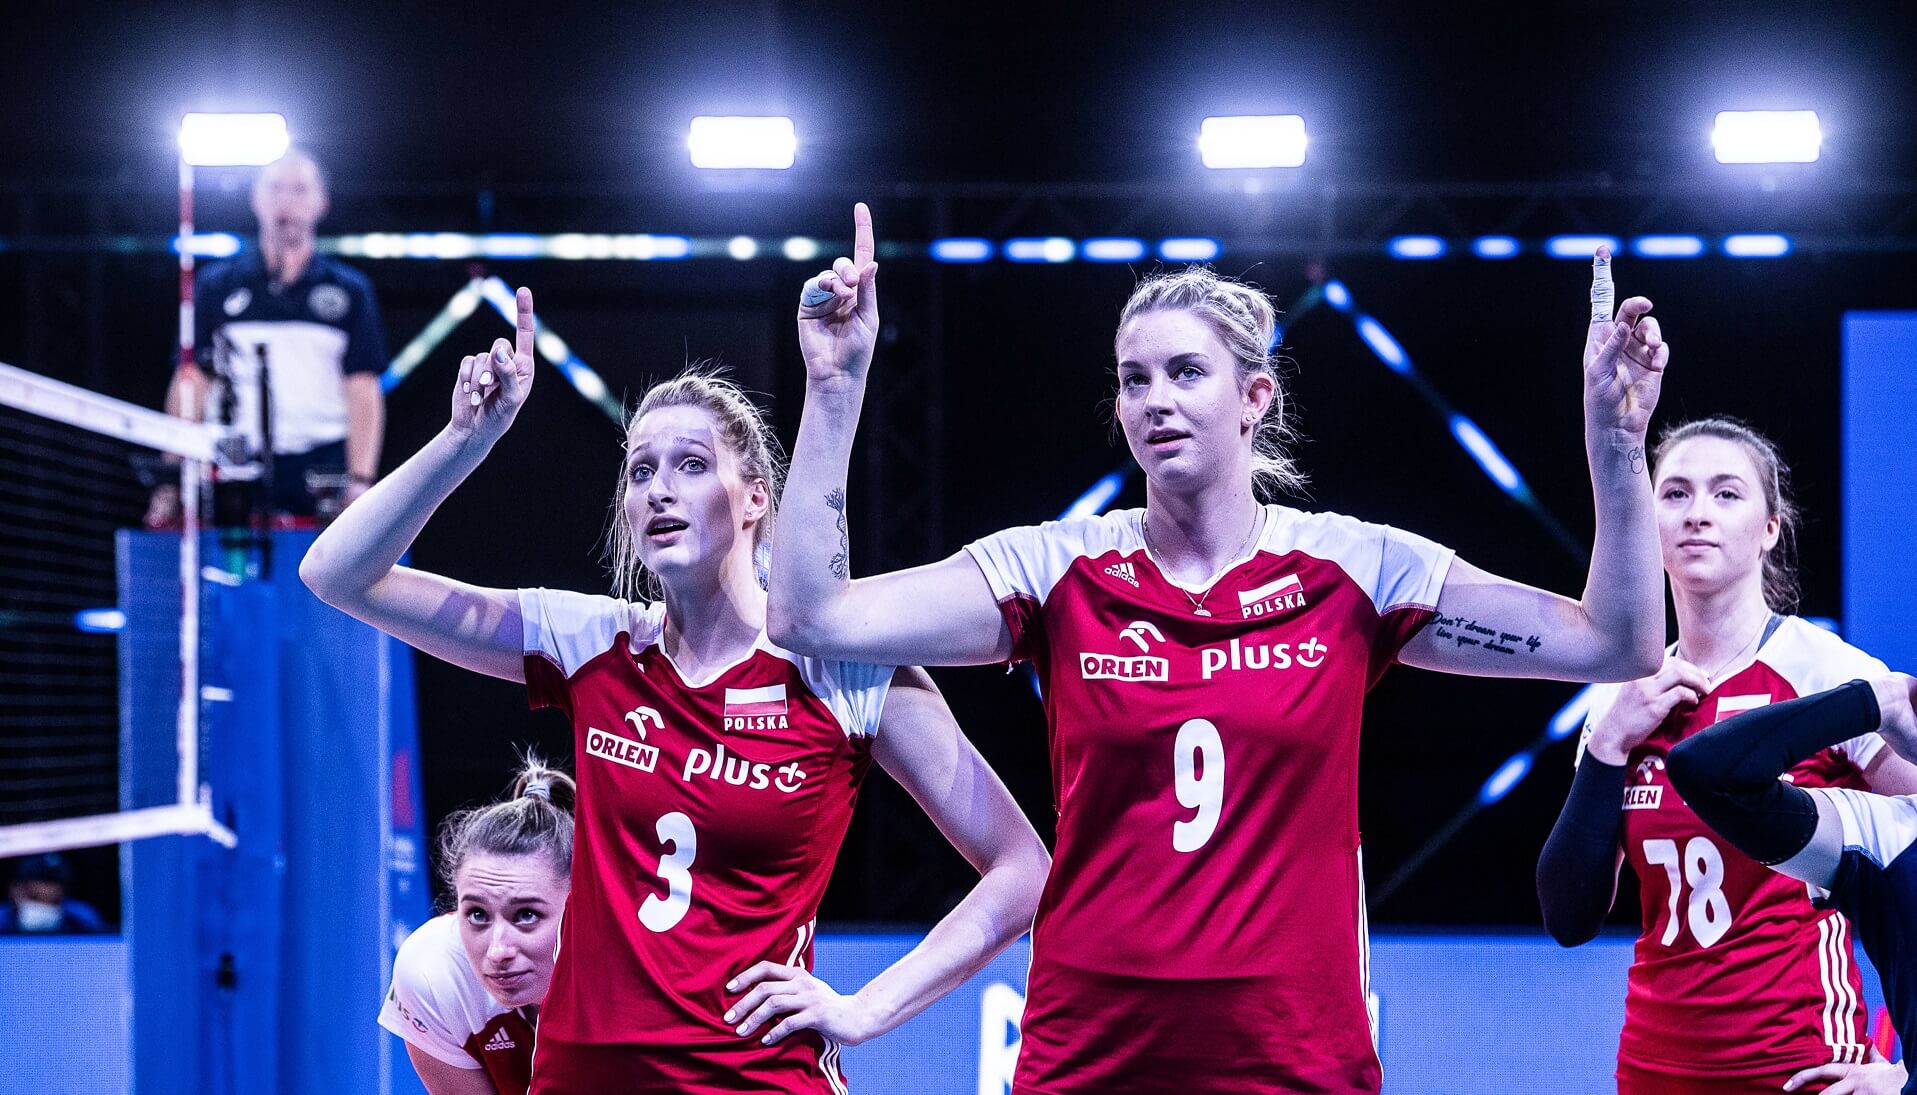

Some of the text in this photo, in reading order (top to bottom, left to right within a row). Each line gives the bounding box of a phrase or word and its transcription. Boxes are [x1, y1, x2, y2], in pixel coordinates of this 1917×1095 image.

[1104, 567, 1140, 588] adidas
[1242, 592, 1307, 620] POLSKA
[1428, 611, 1542, 653] Don't dream your life
[1436, 626, 1453, 640] live
[1456, 635, 1480, 647] your
[1083, 656, 1164, 678] ORLEN
[1201, 638, 1293, 680] plus
[724, 716, 789, 731] POLSKA
[589, 733, 654, 768] ORLEN
[682, 743, 772, 790] plus
[1173, 719, 1225, 853] 9
[1624, 790, 1658, 805] RLEN
[638, 811, 697, 933] 3
[1642, 836, 1733, 949] 78
[484, 1041, 516, 1051] adidas
